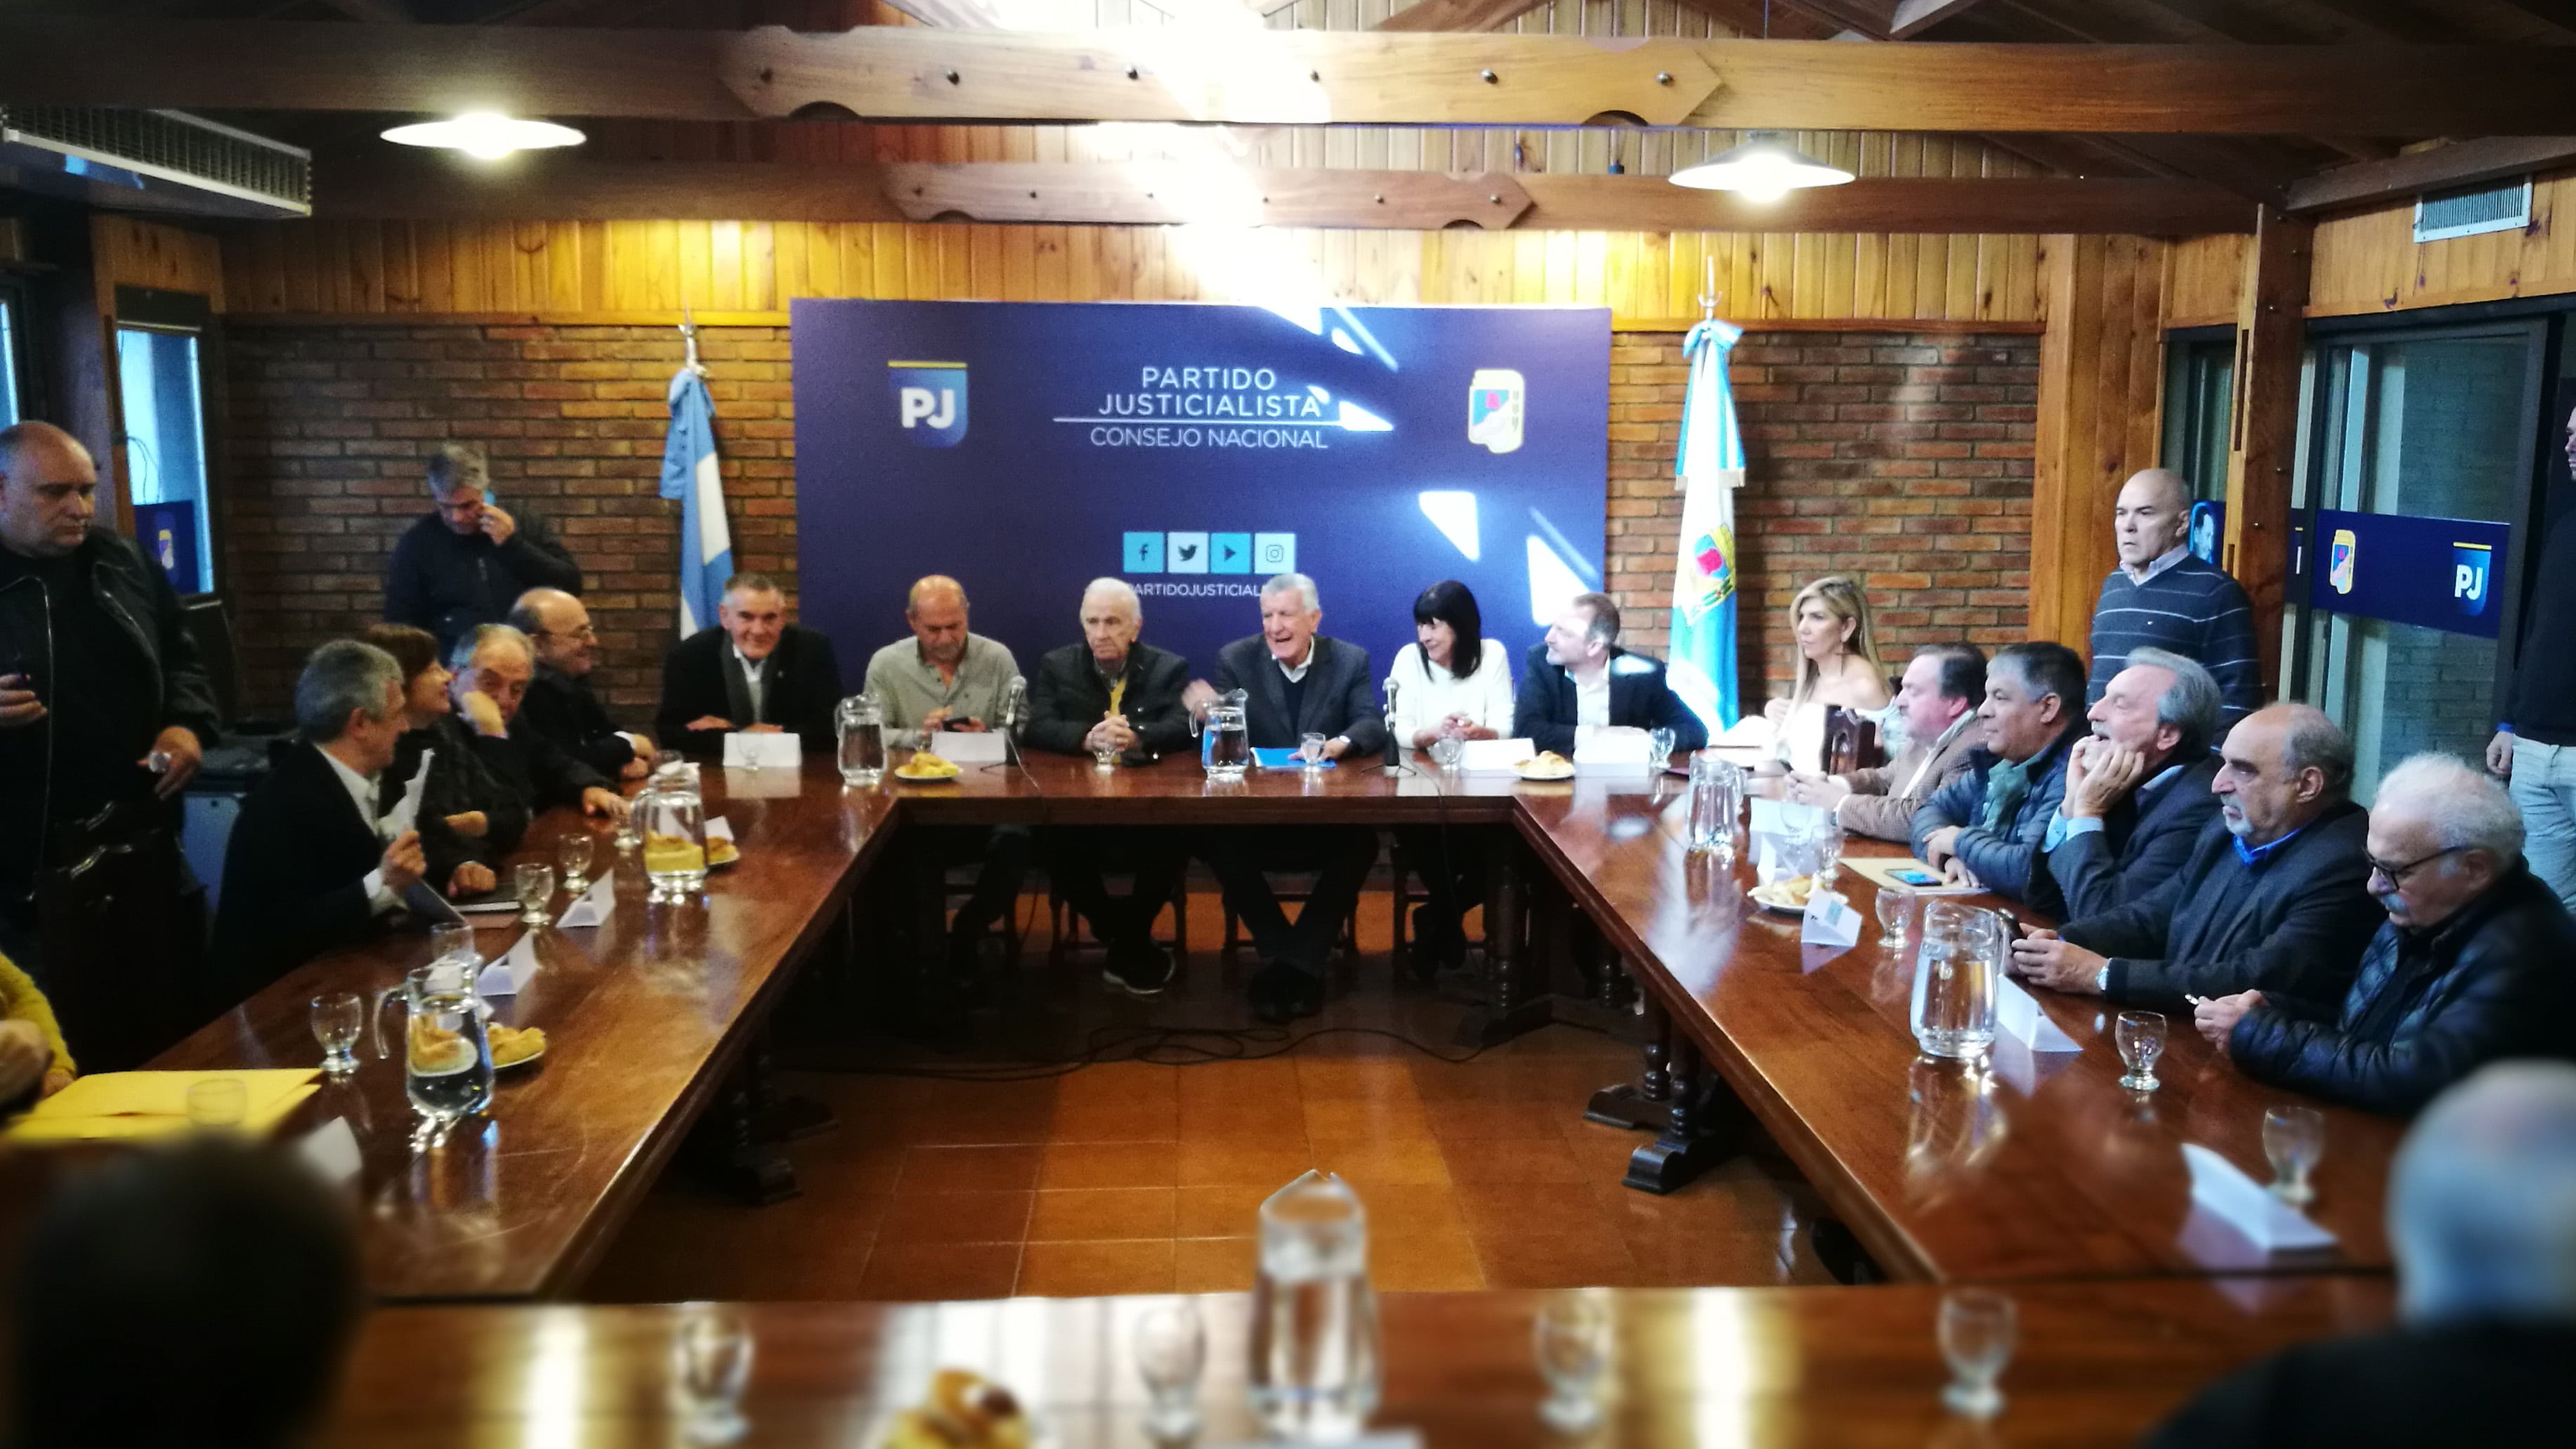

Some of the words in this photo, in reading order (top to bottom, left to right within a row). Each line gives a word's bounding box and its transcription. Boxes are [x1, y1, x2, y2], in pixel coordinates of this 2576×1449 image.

[1142, 367, 1276, 391] PARTIDO
[901, 387, 955, 429] PJ
[1098, 394, 1321, 417] JUSTICIALISTA
[1090, 427, 1201, 447] CONSEJO
[1208, 428, 1328, 449] NACIONAL
[2454, 564, 2483, 601] PJ
